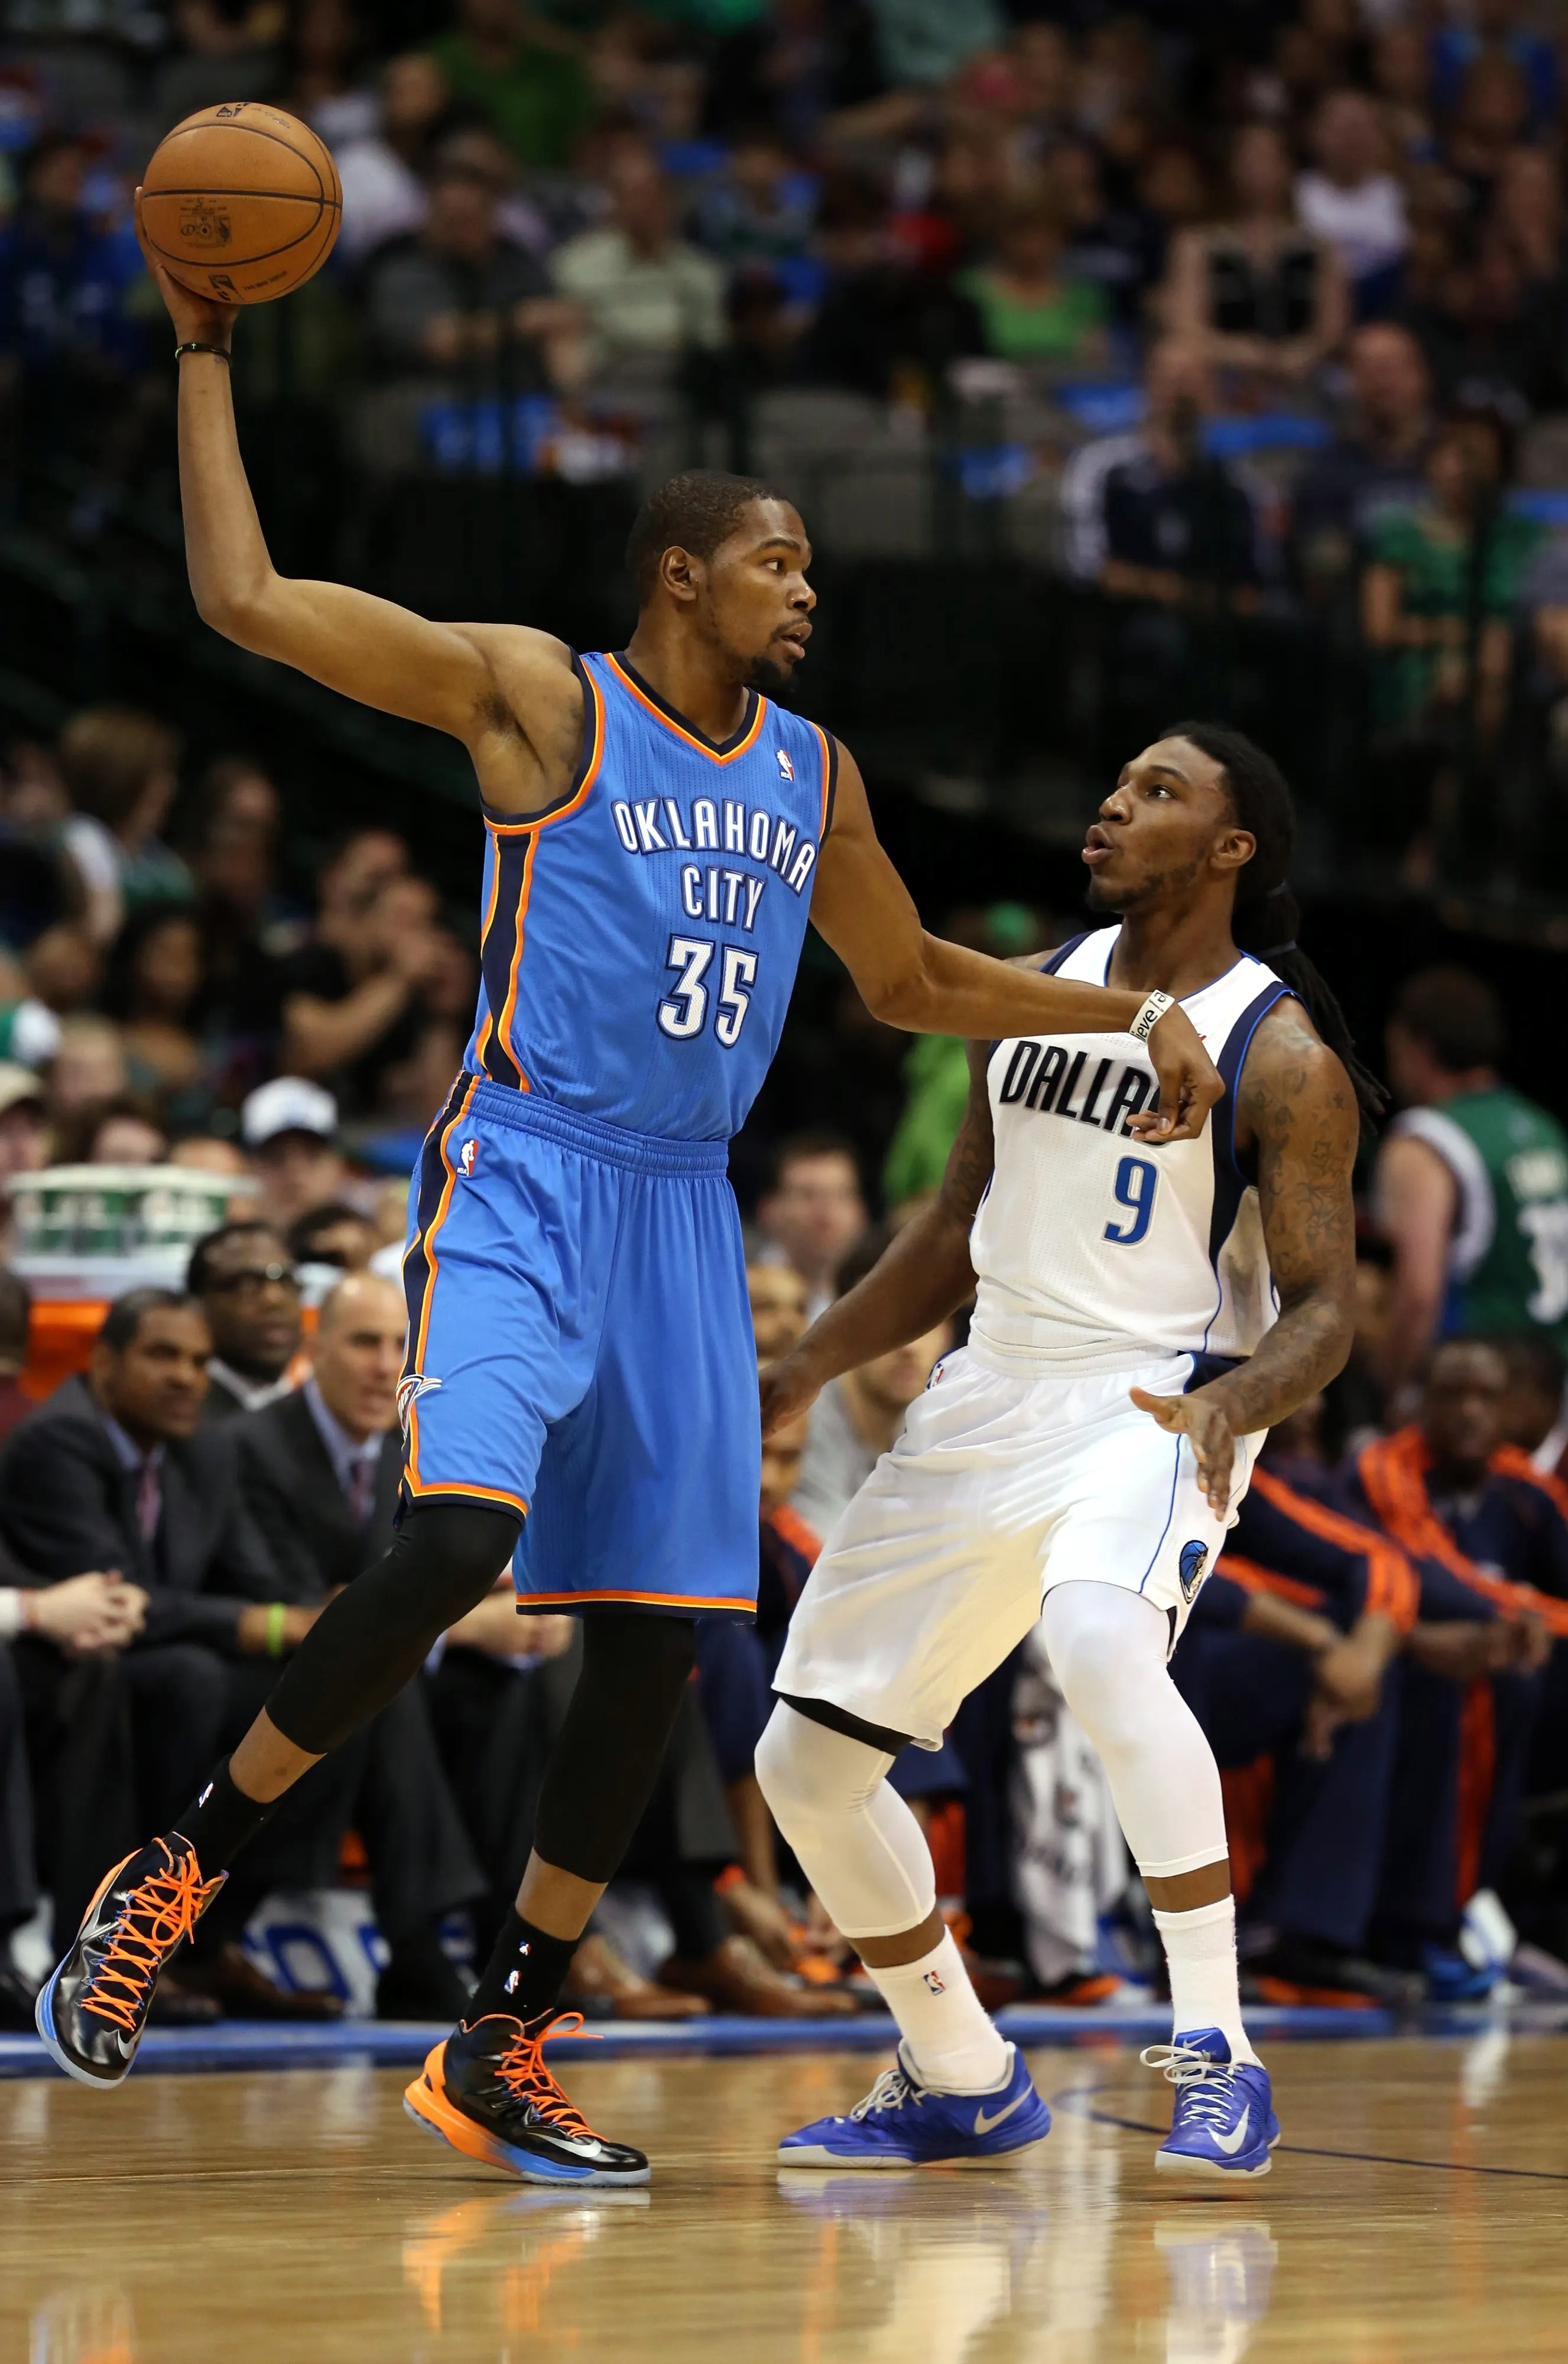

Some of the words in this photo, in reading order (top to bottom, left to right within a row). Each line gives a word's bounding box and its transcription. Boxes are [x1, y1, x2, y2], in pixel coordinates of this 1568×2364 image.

[611, 795, 817, 898] OKLAHOMA
[680, 863, 766, 933] CITY
[655, 933, 759, 1050] 35
[999, 1040, 1170, 1145] DALLA
[1100, 1155, 1160, 1245] 9
